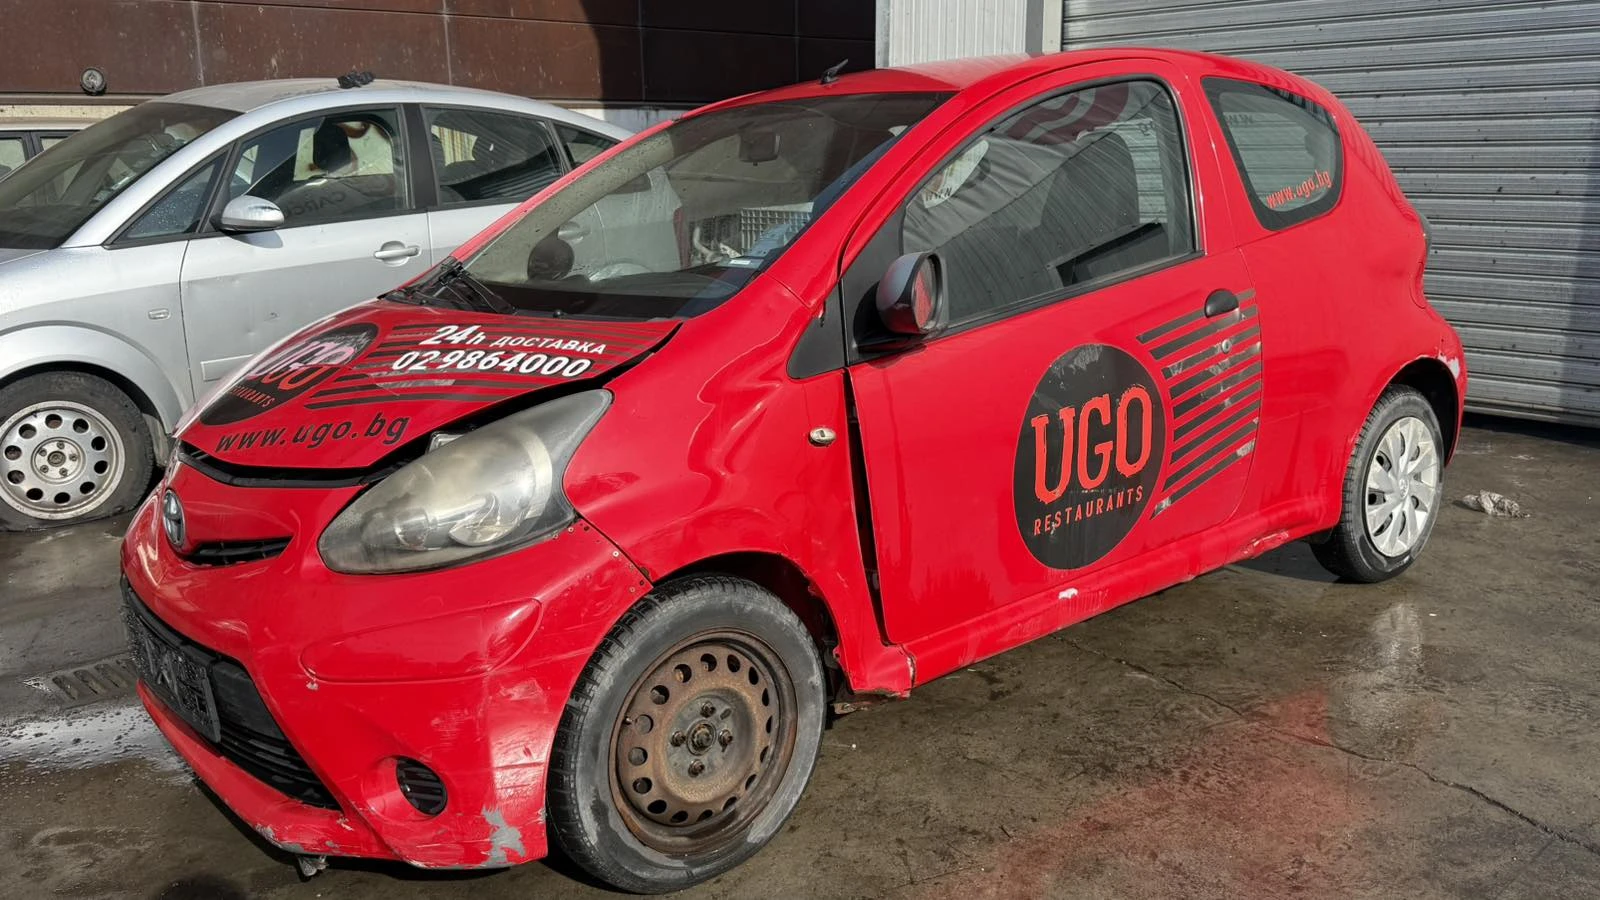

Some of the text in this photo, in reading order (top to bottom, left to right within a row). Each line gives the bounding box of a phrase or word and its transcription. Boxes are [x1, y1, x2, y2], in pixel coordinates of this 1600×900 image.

[1266, 169, 1332, 209] www.ugo.bg
[419, 324, 607, 355] 24h ДОСТАВКА
[440, 350, 592, 378] 9864000
[214, 411, 411, 454] www.ugo.bg
[1030, 384, 1153, 505] UGO
[1033, 485, 1145, 537] RESTAURANTS
